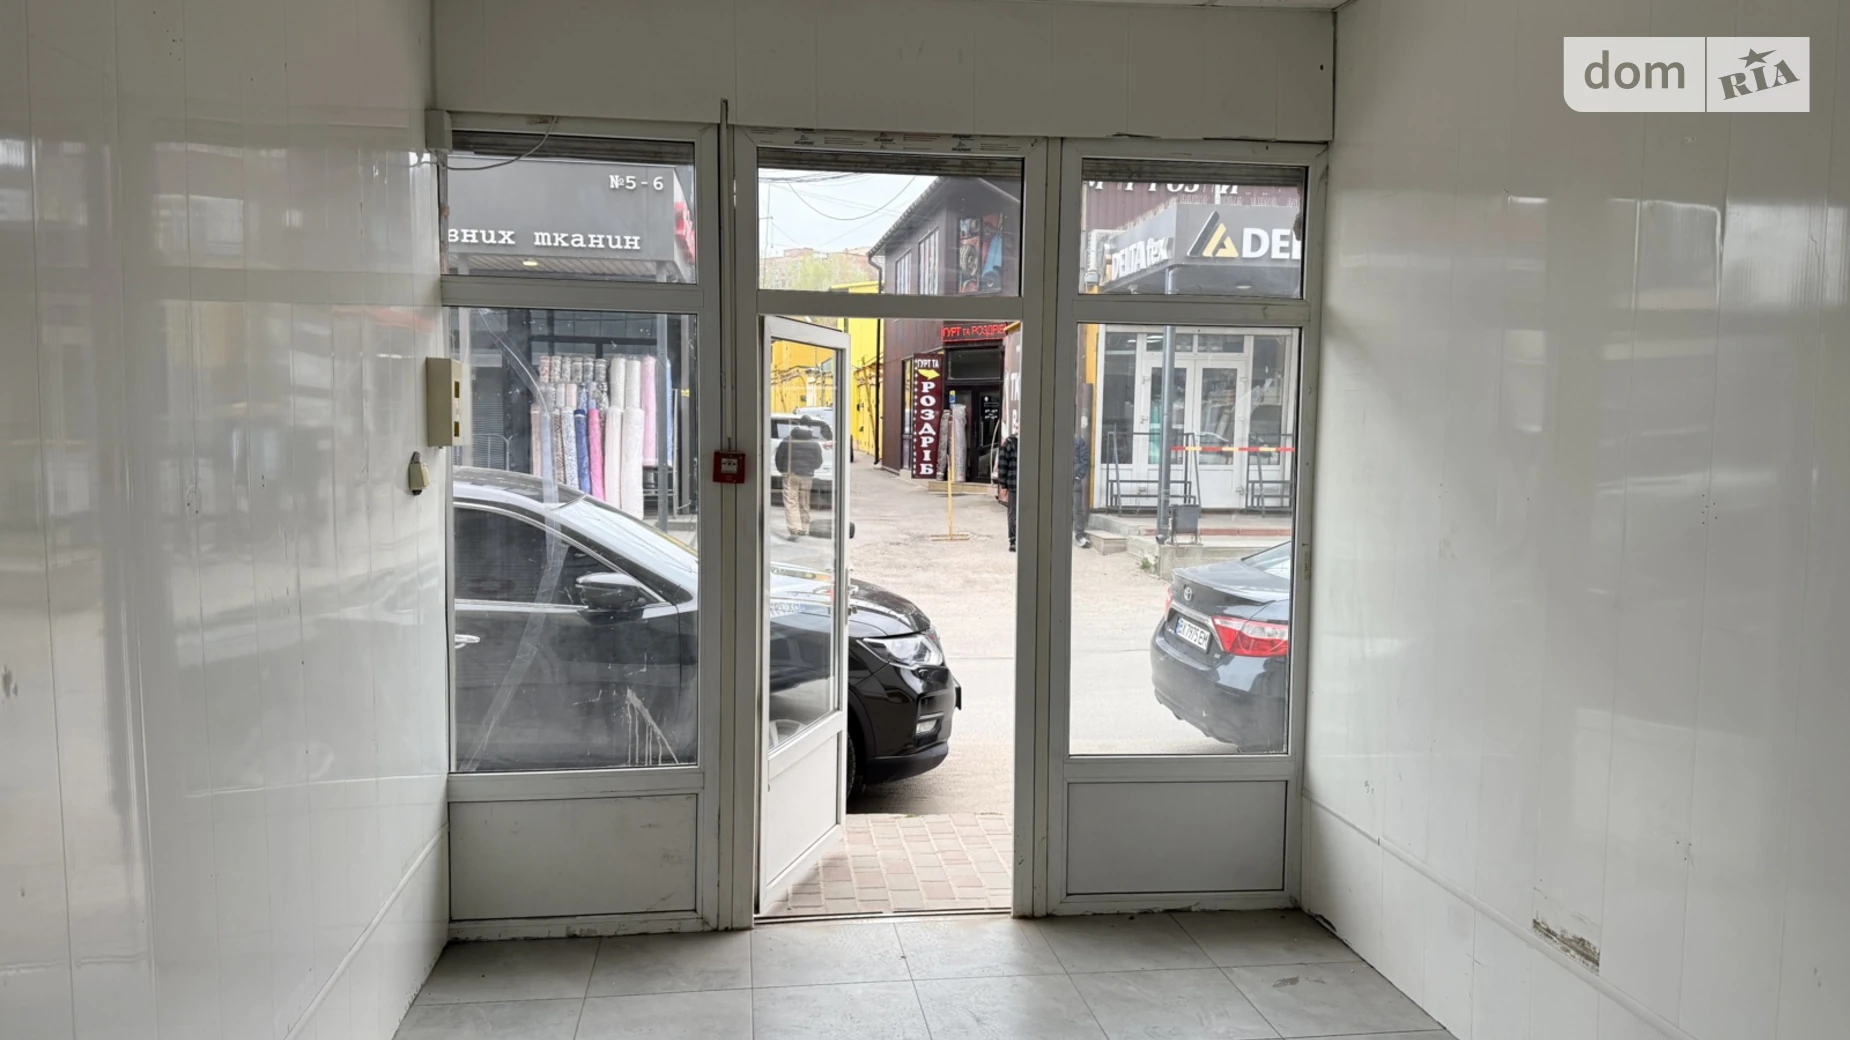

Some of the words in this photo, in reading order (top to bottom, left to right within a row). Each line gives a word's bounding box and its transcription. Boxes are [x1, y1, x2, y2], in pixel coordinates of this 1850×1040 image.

[533, 230, 641, 250] тканин
[1111, 240, 1147, 281] DELTA
[917, 358, 932, 369] ГУРТ
[932, 359, 940, 369] ТА
